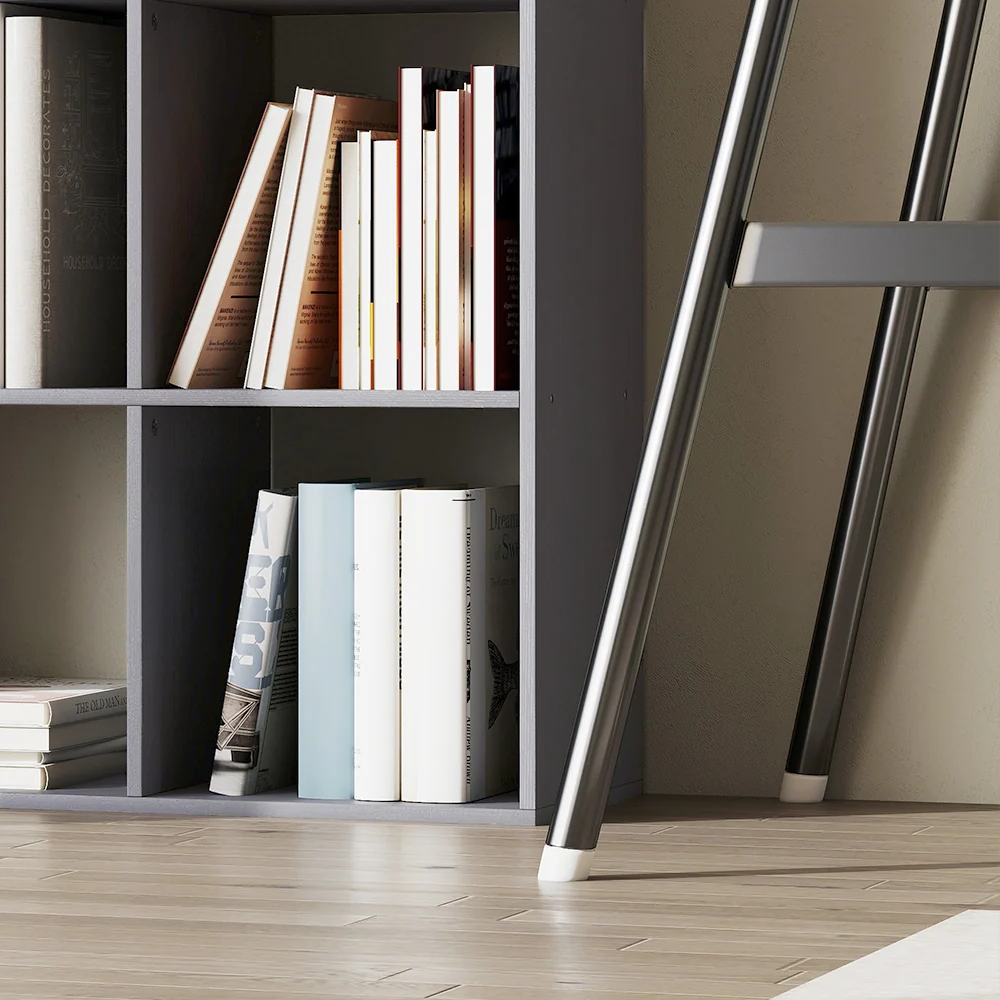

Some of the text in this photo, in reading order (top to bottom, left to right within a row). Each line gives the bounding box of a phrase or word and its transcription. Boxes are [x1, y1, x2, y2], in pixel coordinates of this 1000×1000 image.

[42, 67, 51, 333] HOUSEHOLD DECORATES
[62, 254, 104, 270] HOUSEHOLD
[74, 701, 90, 715] THE
[90, 698, 105, 712] OLD
